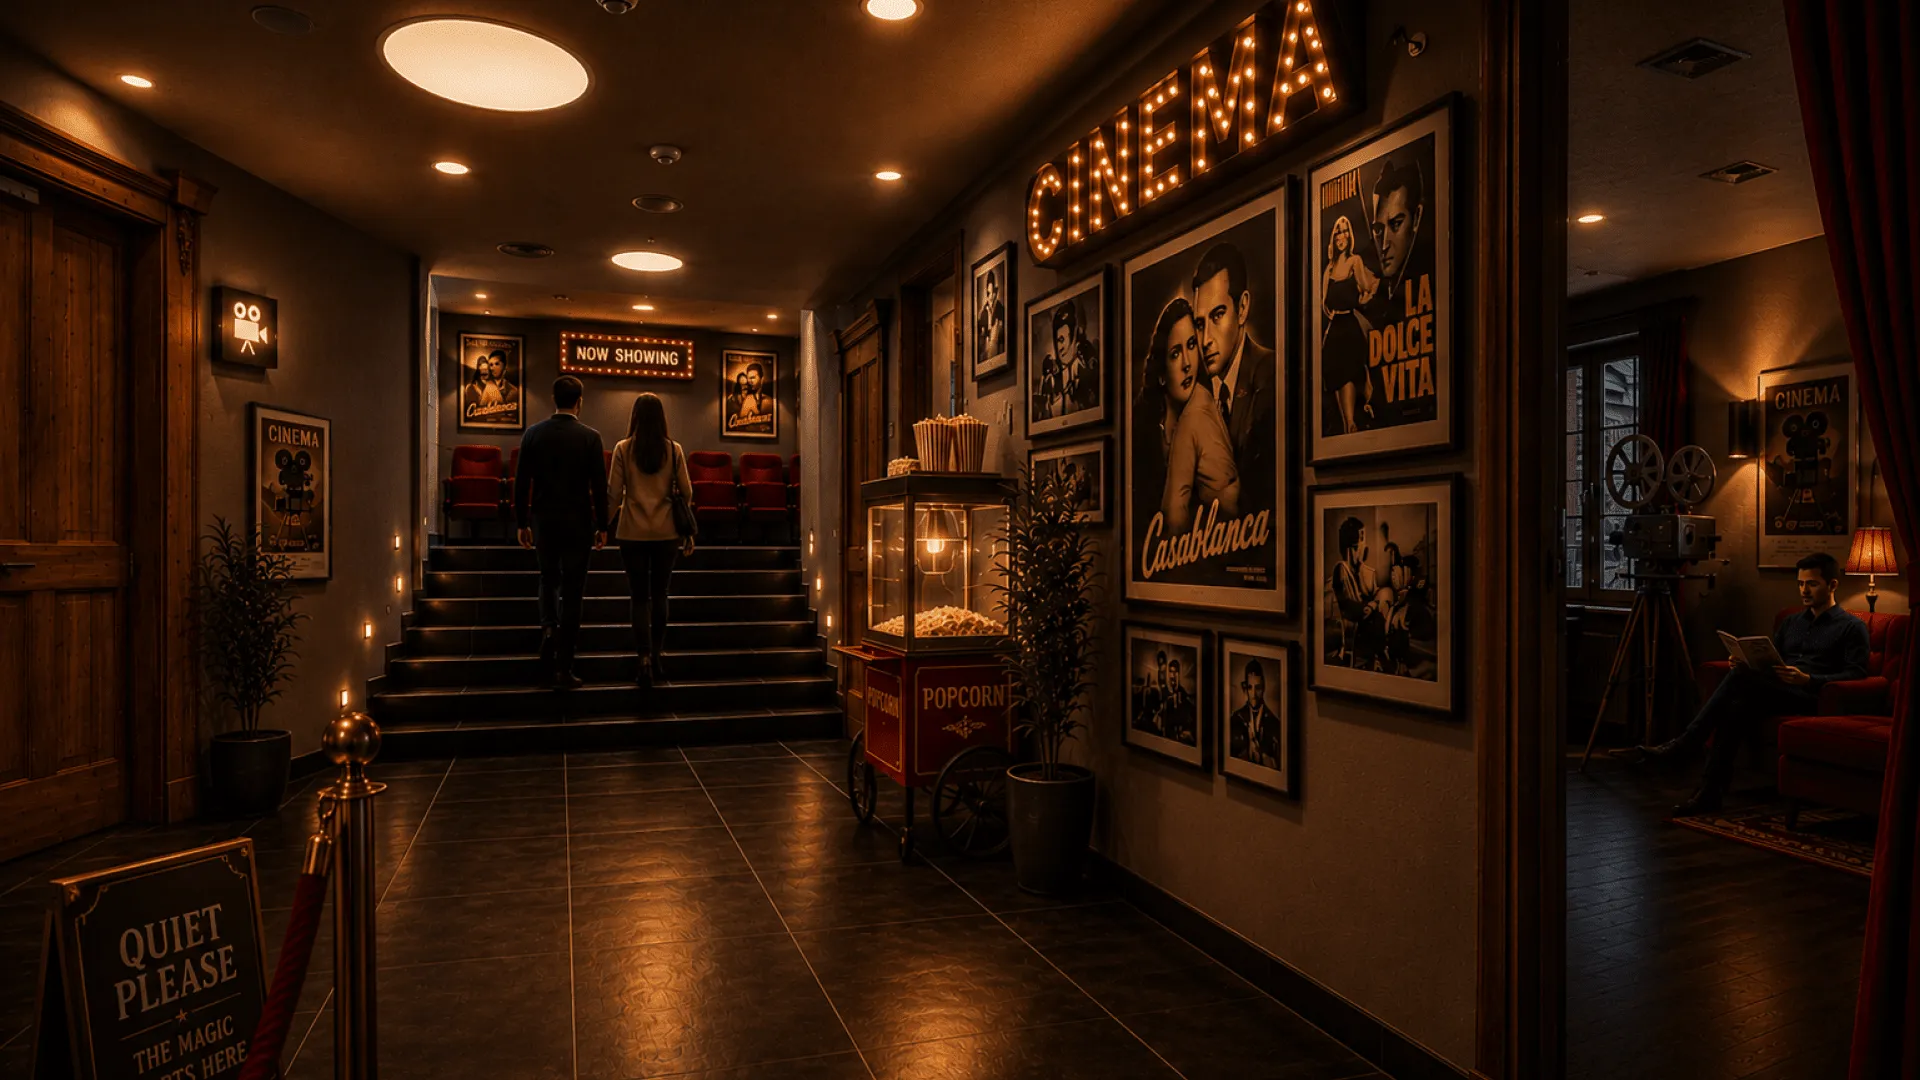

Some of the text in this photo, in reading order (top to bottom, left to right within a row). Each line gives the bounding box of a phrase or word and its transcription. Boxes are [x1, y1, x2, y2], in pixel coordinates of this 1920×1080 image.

[1027, 0, 1339, 261] CINEMA
[1404, 273, 1434, 318] LA
[576, 345, 679, 367] NOW SHOWING
[1368, 314, 1434, 368] DOLCE
[1381, 356, 1435, 403] VITA
[1775, 384, 1841, 411] CINEMA
[268, 424, 320, 449] CINEMA
[1141, 498, 1271, 580] Casablanca
[922, 685, 1005, 710] POPCORN
[119, 903, 222, 970] QUIET
[114, 944, 238, 1021] PLEASE
[132, 1040, 173, 1075] THE
[177, 1014, 235, 1056] MAGIC
[201, 1040, 249, 1079] HERE
